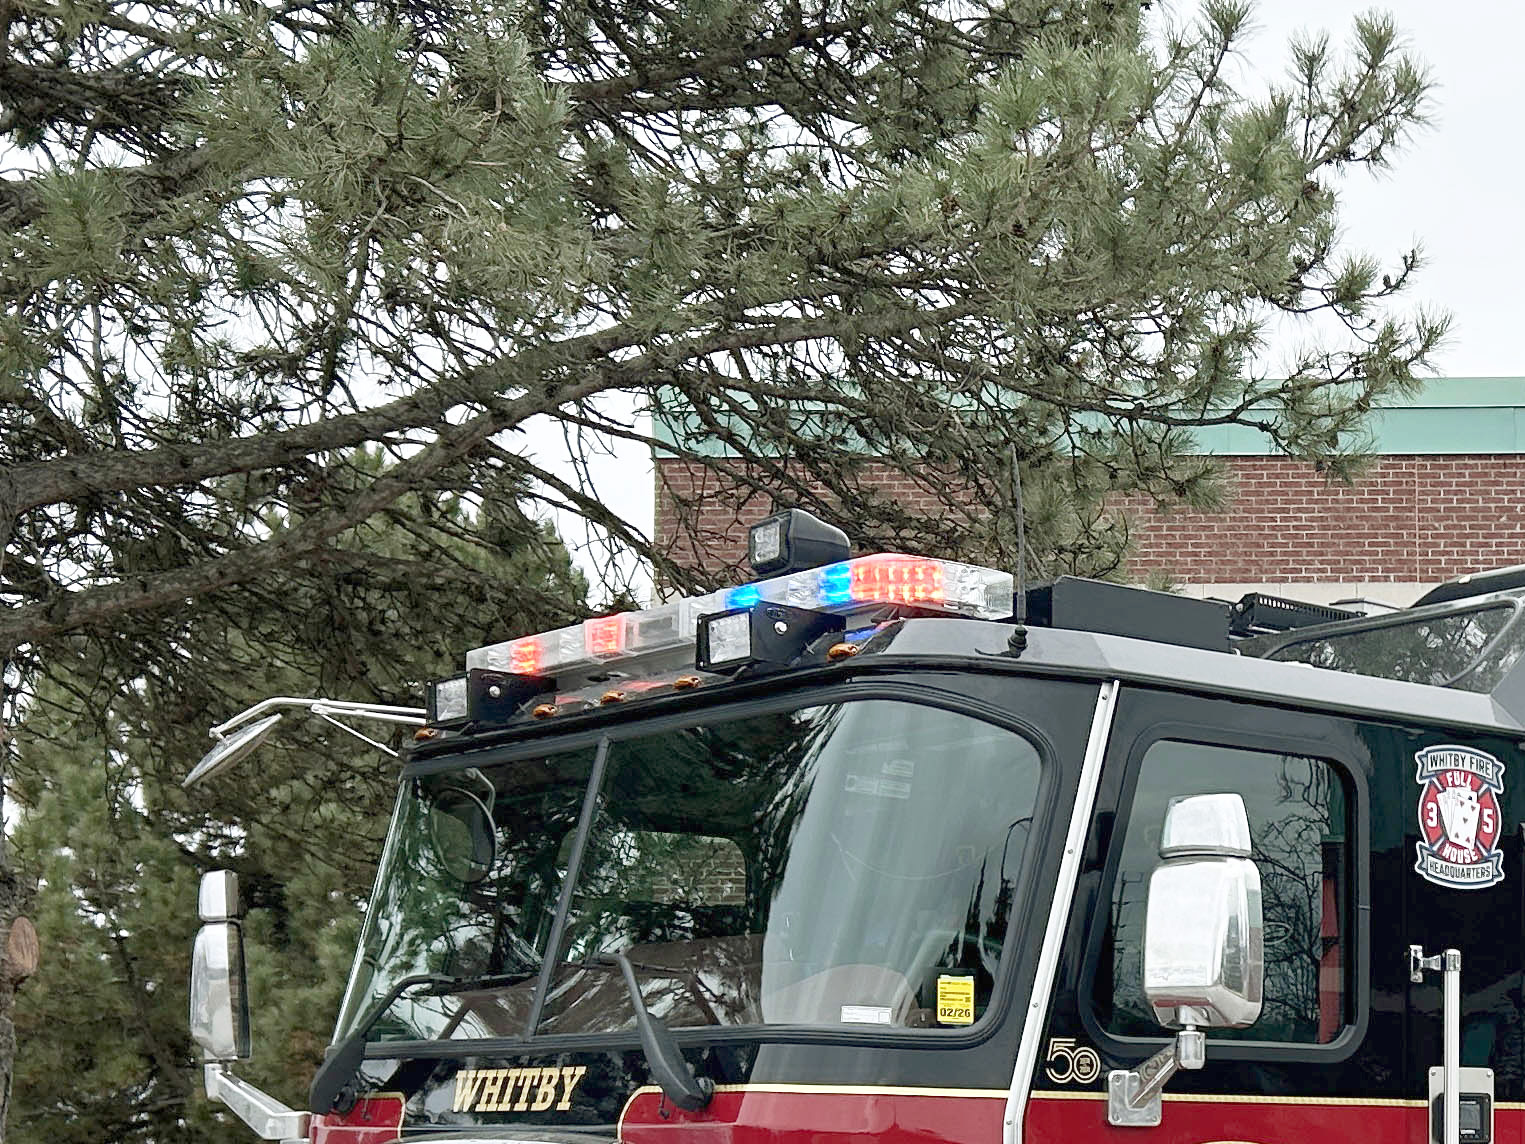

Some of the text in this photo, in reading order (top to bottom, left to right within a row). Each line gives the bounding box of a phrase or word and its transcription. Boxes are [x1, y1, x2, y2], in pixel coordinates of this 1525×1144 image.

[1429, 752, 1491, 777] WHITBY FIRE
[1446, 770, 1472, 788] FULL
[1426, 802, 1494, 834] 3 5
[1442, 843, 1479, 864] HOUSE
[1429, 862, 1491, 880] HEADQUARTERS
[940, 1007, 971, 1018] 02/26
[1045, 1037, 1101, 1084] 50
[453, 1065, 587, 1113] WHITBY
